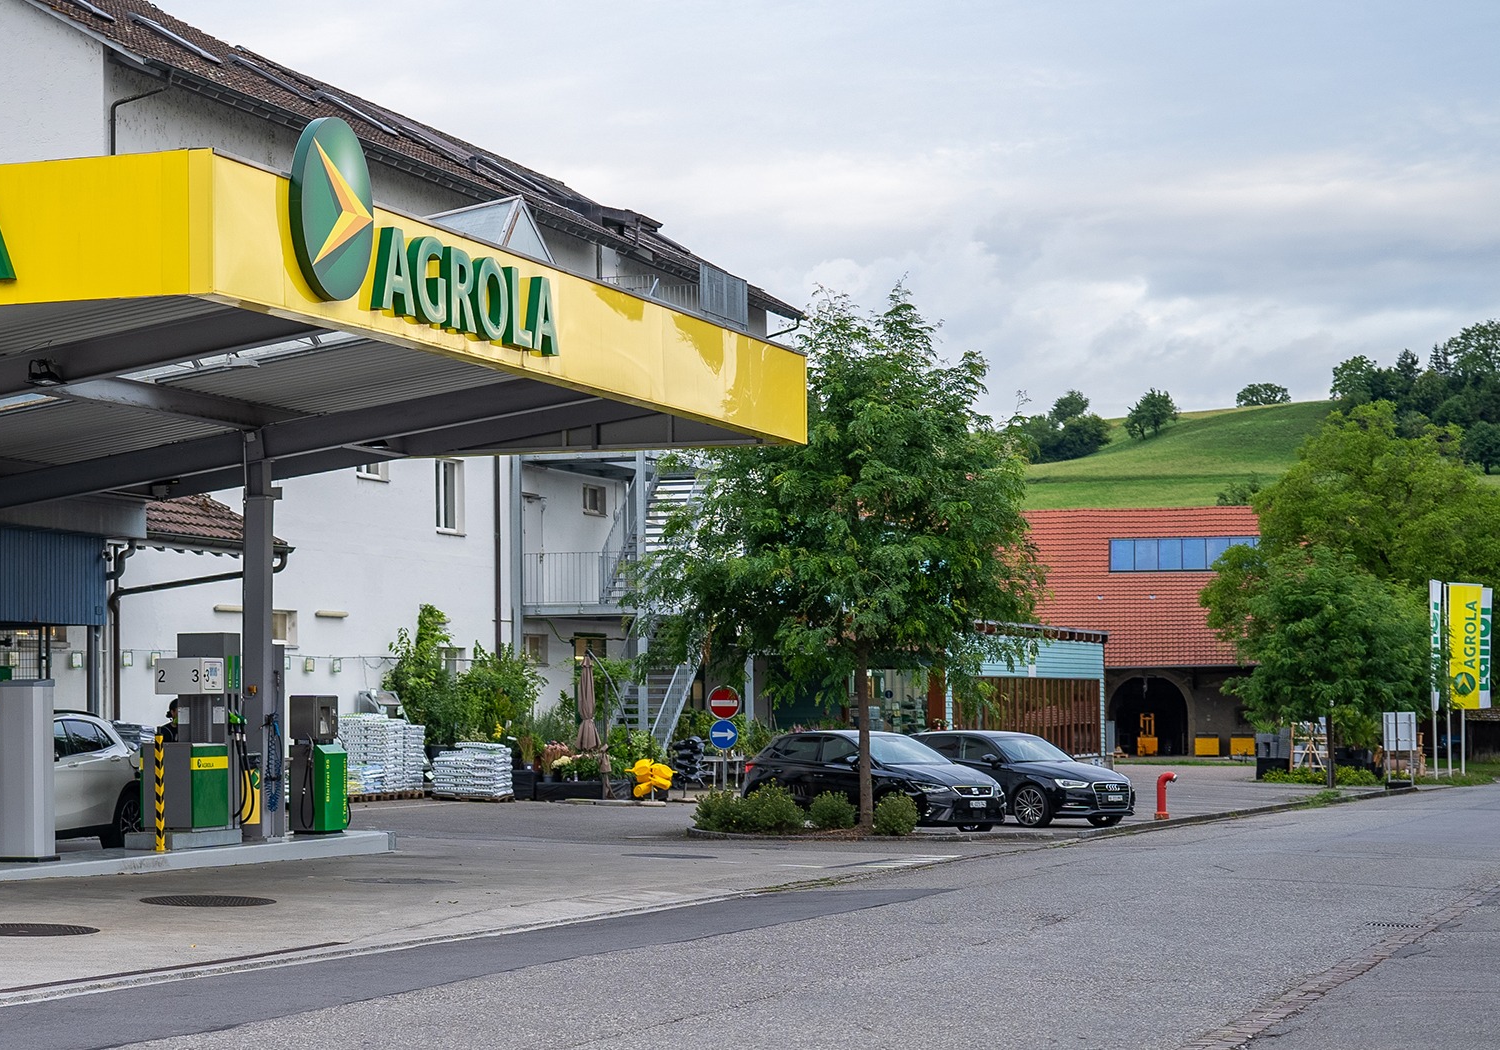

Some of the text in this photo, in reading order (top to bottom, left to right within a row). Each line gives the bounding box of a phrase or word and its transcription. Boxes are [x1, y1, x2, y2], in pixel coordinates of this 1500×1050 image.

[371, 226, 559, 356] AGROLA
[1464, 600, 1478, 670] AGROLA
[158, 669, 166, 683] 2
[191, 669, 199, 683] 3
[205, 669, 210, 683] 3
